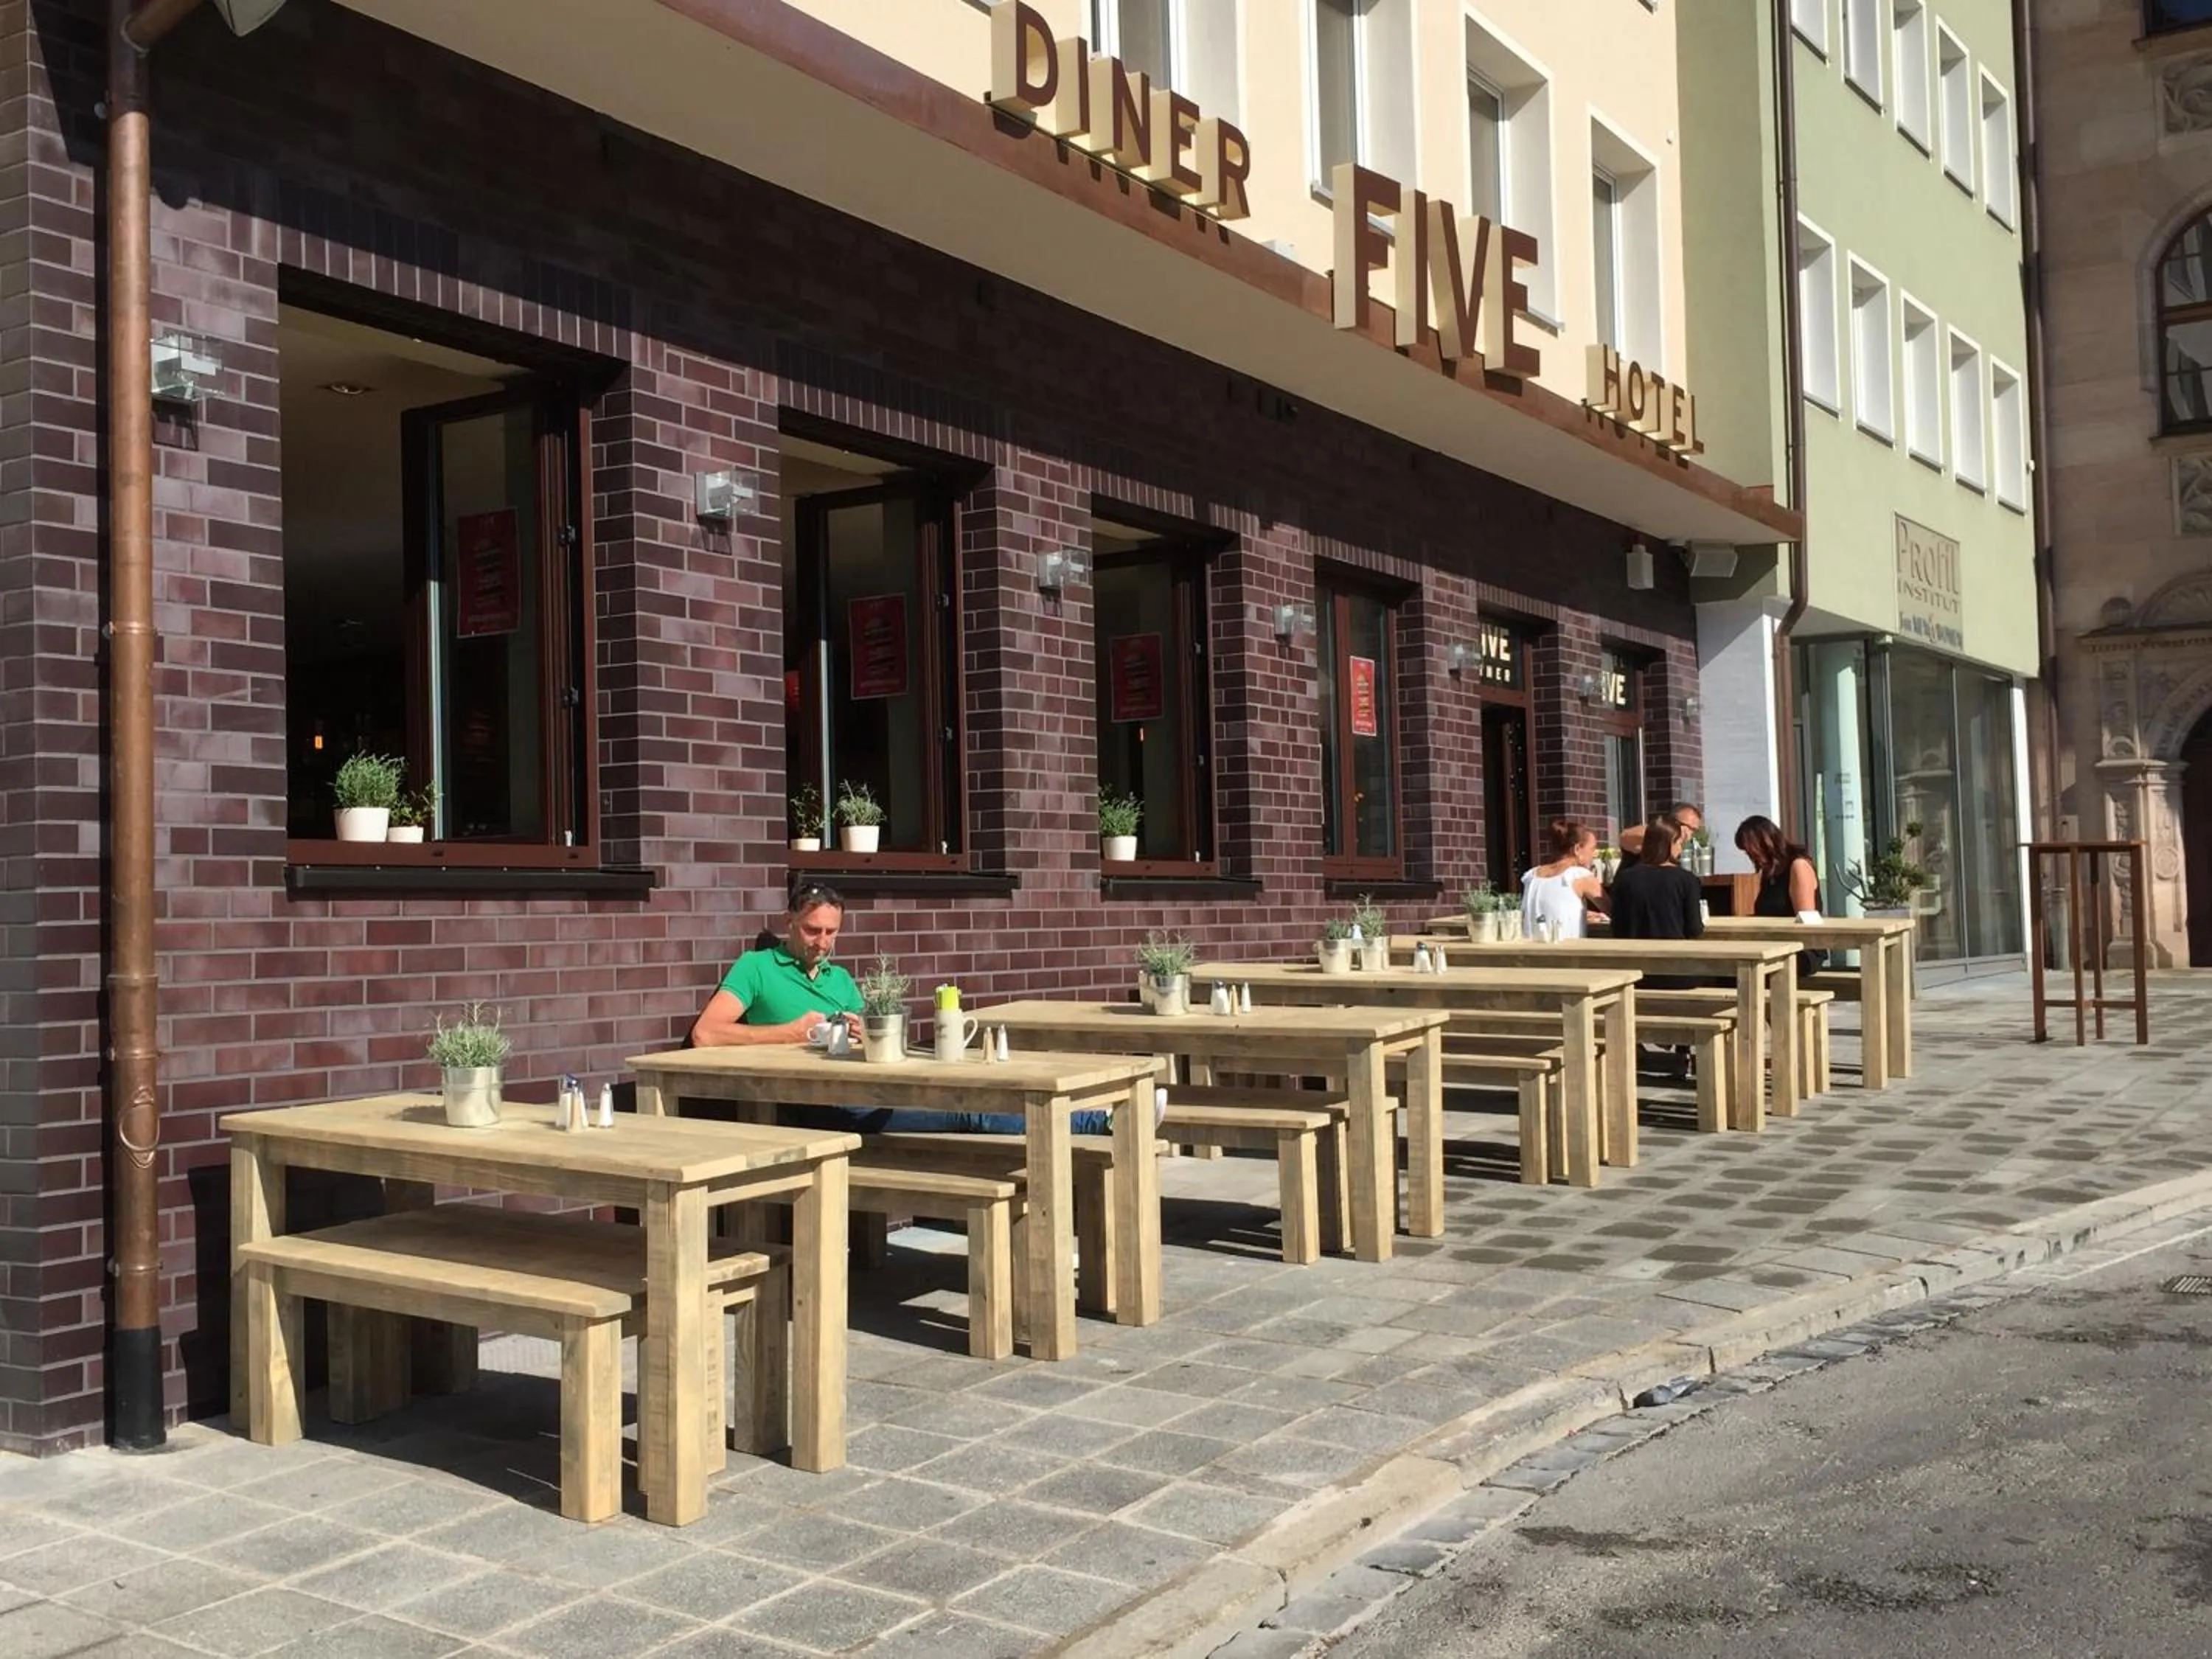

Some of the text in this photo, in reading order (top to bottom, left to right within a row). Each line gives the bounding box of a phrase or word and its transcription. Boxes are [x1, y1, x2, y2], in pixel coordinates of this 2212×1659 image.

[991, 0, 1704, 456] DINER FIVE HOTEL
[1897, 578, 1958, 614] INSTITUT
[1481, 633, 1511, 662] IVE
[1601, 670, 1626, 706] IVE
